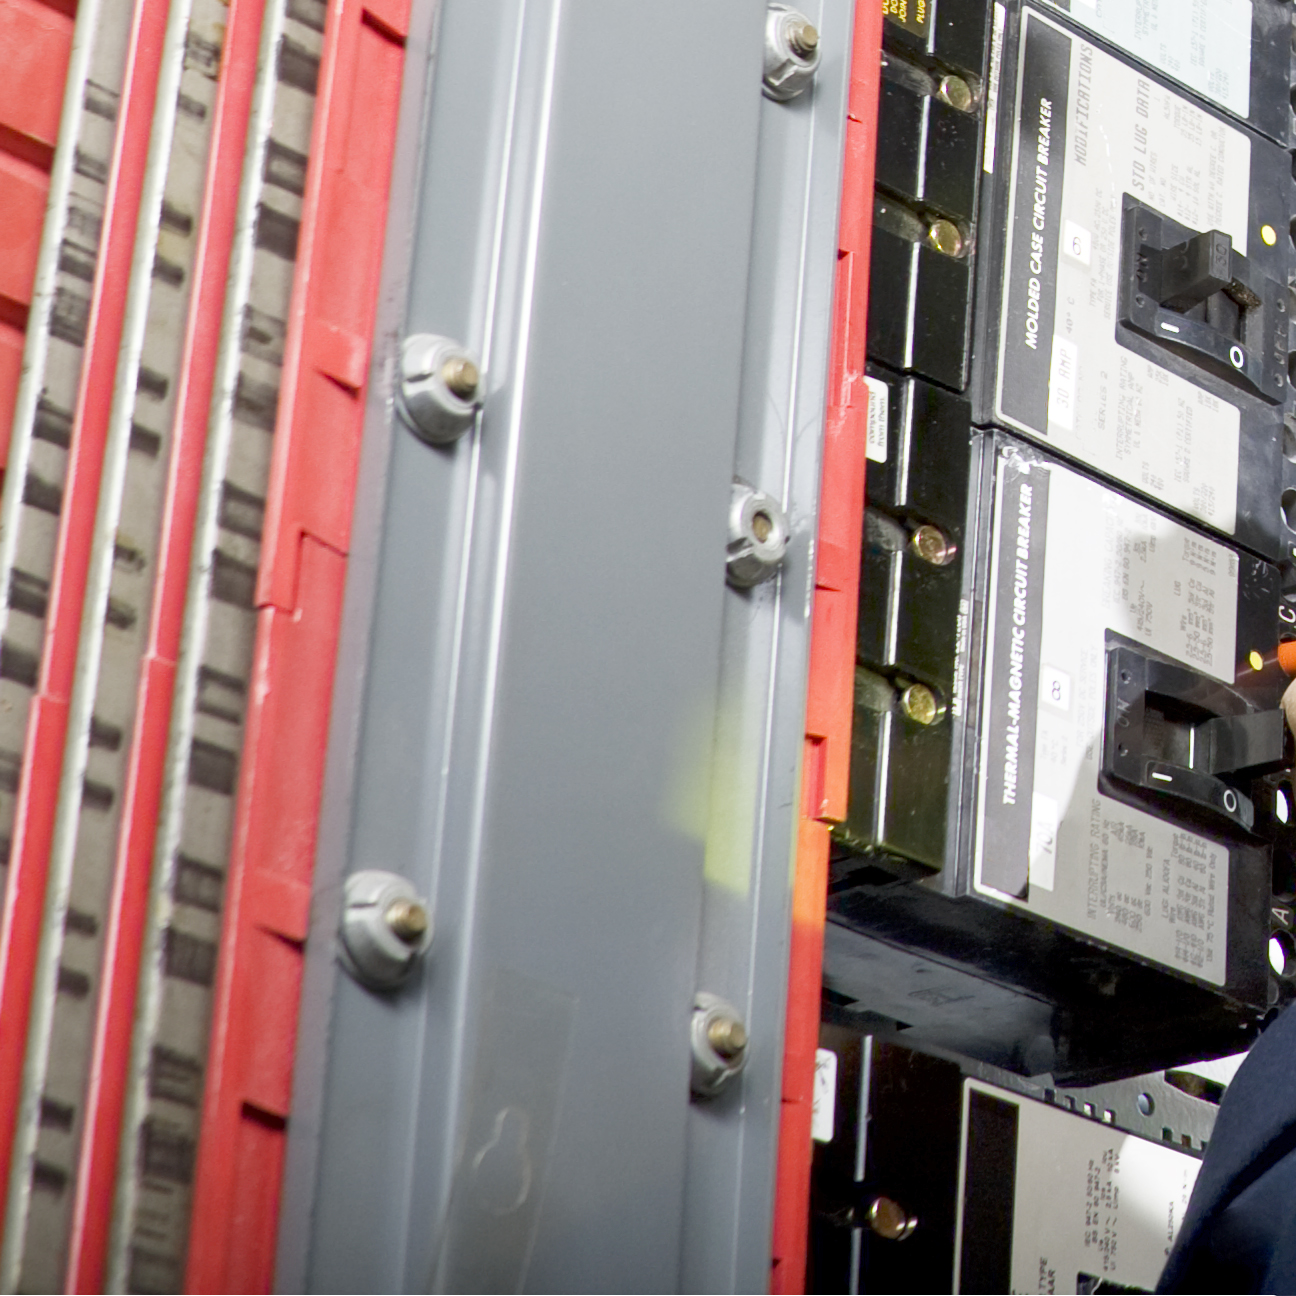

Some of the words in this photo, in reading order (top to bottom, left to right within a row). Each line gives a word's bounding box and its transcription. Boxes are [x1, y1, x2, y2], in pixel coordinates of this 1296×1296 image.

[1073, 41, 1093, 167] MODIFICATIONS
[1135, 77, 1149, 119] DATA
[1036, 95, 1052, 166] BREAKER
[1133, 122, 1147, 155] LUG
[1131, 158, 1145, 191] STD
[1032, 165, 1048, 232] CIRCUIT
[1030, 230, 1044, 277] CASE
[1025, 274, 1042, 351] MOLDED
[1067, 294, 1074, 306] C
[1058, 346, 1071, 380] AMP
[1100, 368, 1108, 380] 2
[1119, 354, 1127, 391] RATING
[1056, 386, 1069, 409] 30
[1097, 383, 1107, 431] SERIES
[1115, 392, 1125, 461] INTERRUPTING
[1124, 393, 1134, 455] SYMMETRICAL
[1015, 480, 1032, 561] BREAKER
[1012, 558, 1028, 628] CIRCUIT
[1278, 606, 1296, 624] C
[1051, 680, 1061, 701] 8
[1003, 625, 1025, 808] THERMAL-MAGNETIC
[1035, 817, 1053, 857] 70A
[1090, 797, 1101, 839] RATING
[1086, 840, 1099, 920] INTERRUPTING
[1271, 907, 1289, 926] A
[1039, 1257, 1047, 1291] TYPE
